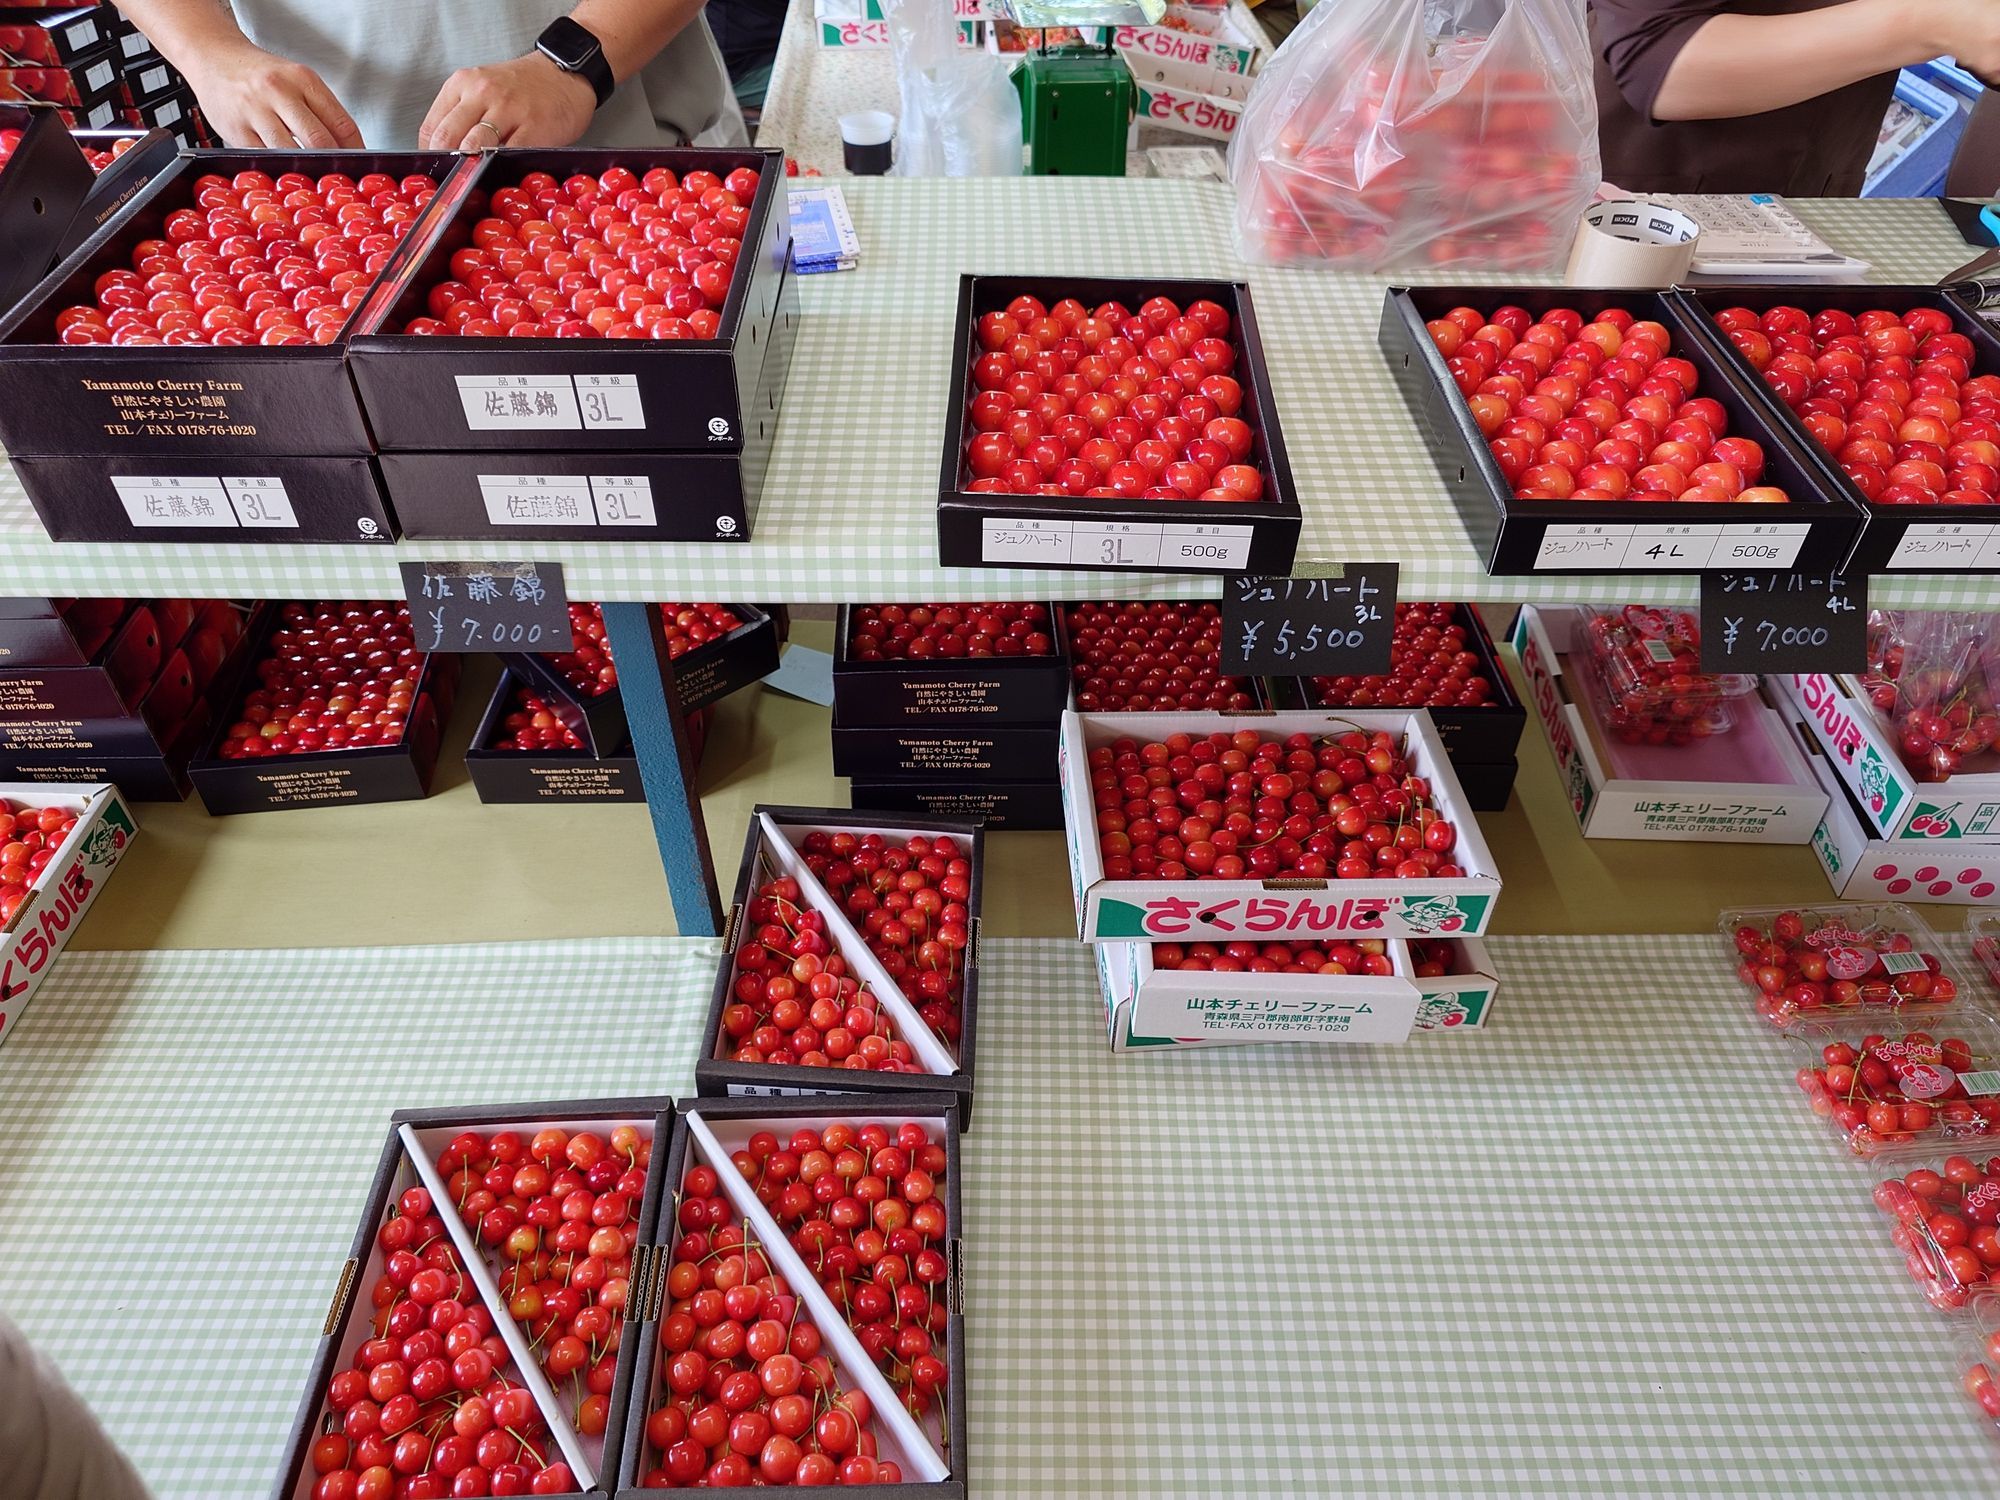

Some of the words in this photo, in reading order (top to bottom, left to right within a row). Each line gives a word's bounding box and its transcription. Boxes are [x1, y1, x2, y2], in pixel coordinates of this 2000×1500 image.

[1151, 92, 1237, 133] さくらん
[119, 186, 137, 203] Cherry
[135, 176, 148, 190] Farm
[81, 380, 154, 390] Yamamoto
[157, 380, 203, 393] Cherry
[206, 380, 244, 390] Farm
[498, 377, 529, 386] 品種
[111, 395, 226, 407] 自然にやさしい農園
[485, 390, 558, 418] 佐藤錦
[586, 392, 623, 422] 3L
[121, 409, 229, 421] 山本チェリーファーム
[178, 425, 257, 436] 0178-76-1020
[151, 478, 181, 487] 品種
[237, 478, 267, 487] 等級
[518, 477, 547, 486] 品種
[605, 477, 634, 486] 等級
[144, 494, 215, 518] 佐藤錦
[242, 493, 281, 521] 3L
[506, 494, 579, 519] 佐藤錦
[605, 492, 642, 521] 3L
[1015, 521, 1040, 529] 品種
[1105, 524, 1130, 532] 規格
[1936, 526, 1961, 534] 品種
[994, 532, 1063, 546] ジュノハート
[1101, 538, 1133, 564] 3L
[1181, 545, 1228, 560] 500g
[1545, 538, 1613, 555] ジュノハート
[1732, 545, 1780, 559] 500g
[1904, 538, 1971, 553] ジュノハート
[1826, 595, 1857, 614] 4L
[1355, 605, 1382, 624] 3L
[1793, 674, 1867, 766] らんぼ
[310, 790, 358, 799] 0178-76-1020
[1634, 801, 1787, 817] 山本チェリーファーム
[1688, 825, 1765, 834] 0178-76-1020
[1146, 896, 1400, 934] さくらんぼ
[0, 852, 94, 1033] くらんぼ
[1186, 997, 1374, 1014] 山本チェリーファーム
[1258, 1023, 1350, 1032] 0178-76-1020
[744, 1087, 782, 1096] 品種
